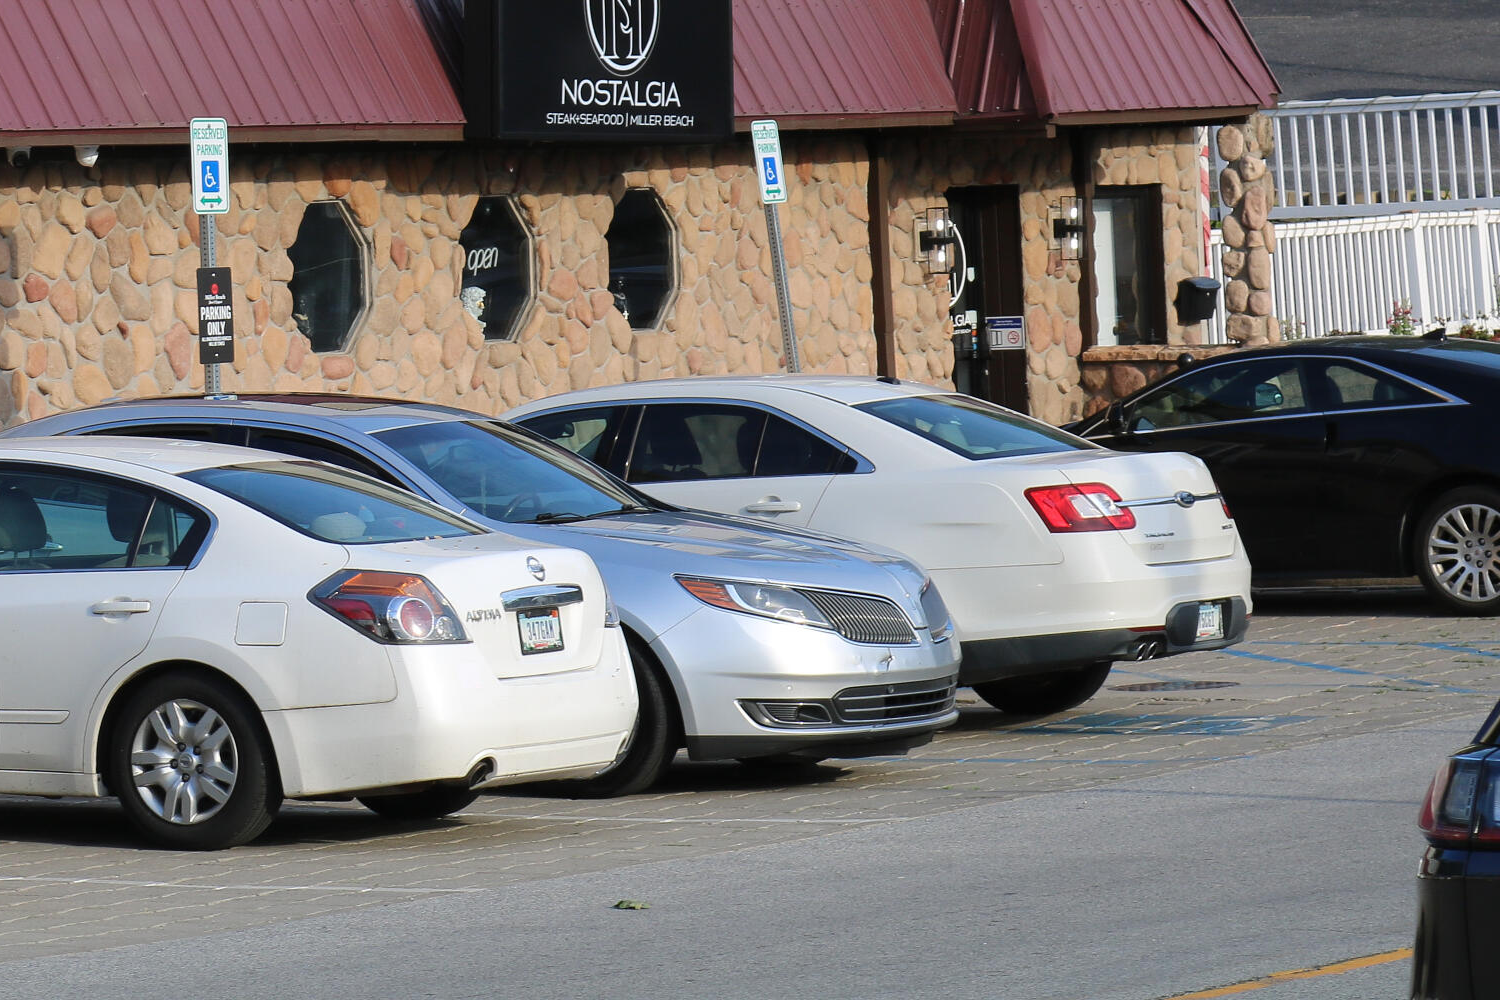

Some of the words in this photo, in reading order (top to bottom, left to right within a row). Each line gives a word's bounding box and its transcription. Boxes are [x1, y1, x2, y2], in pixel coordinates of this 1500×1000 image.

[561, 78, 681, 108] NOSTALGIA
[546, 112, 625, 126] STEAK+SEAFOOD
[630, 113, 662, 126] MILLER
[663, 114, 694, 127] BEACH
[193, 128, 225, 140] RESERVED
[196, 144, 223, 156] PARKING
[467, 246, 498, 276] open
[200, 305, 231, 320] PARKING
[207, 321, 226, 336] ONLY
